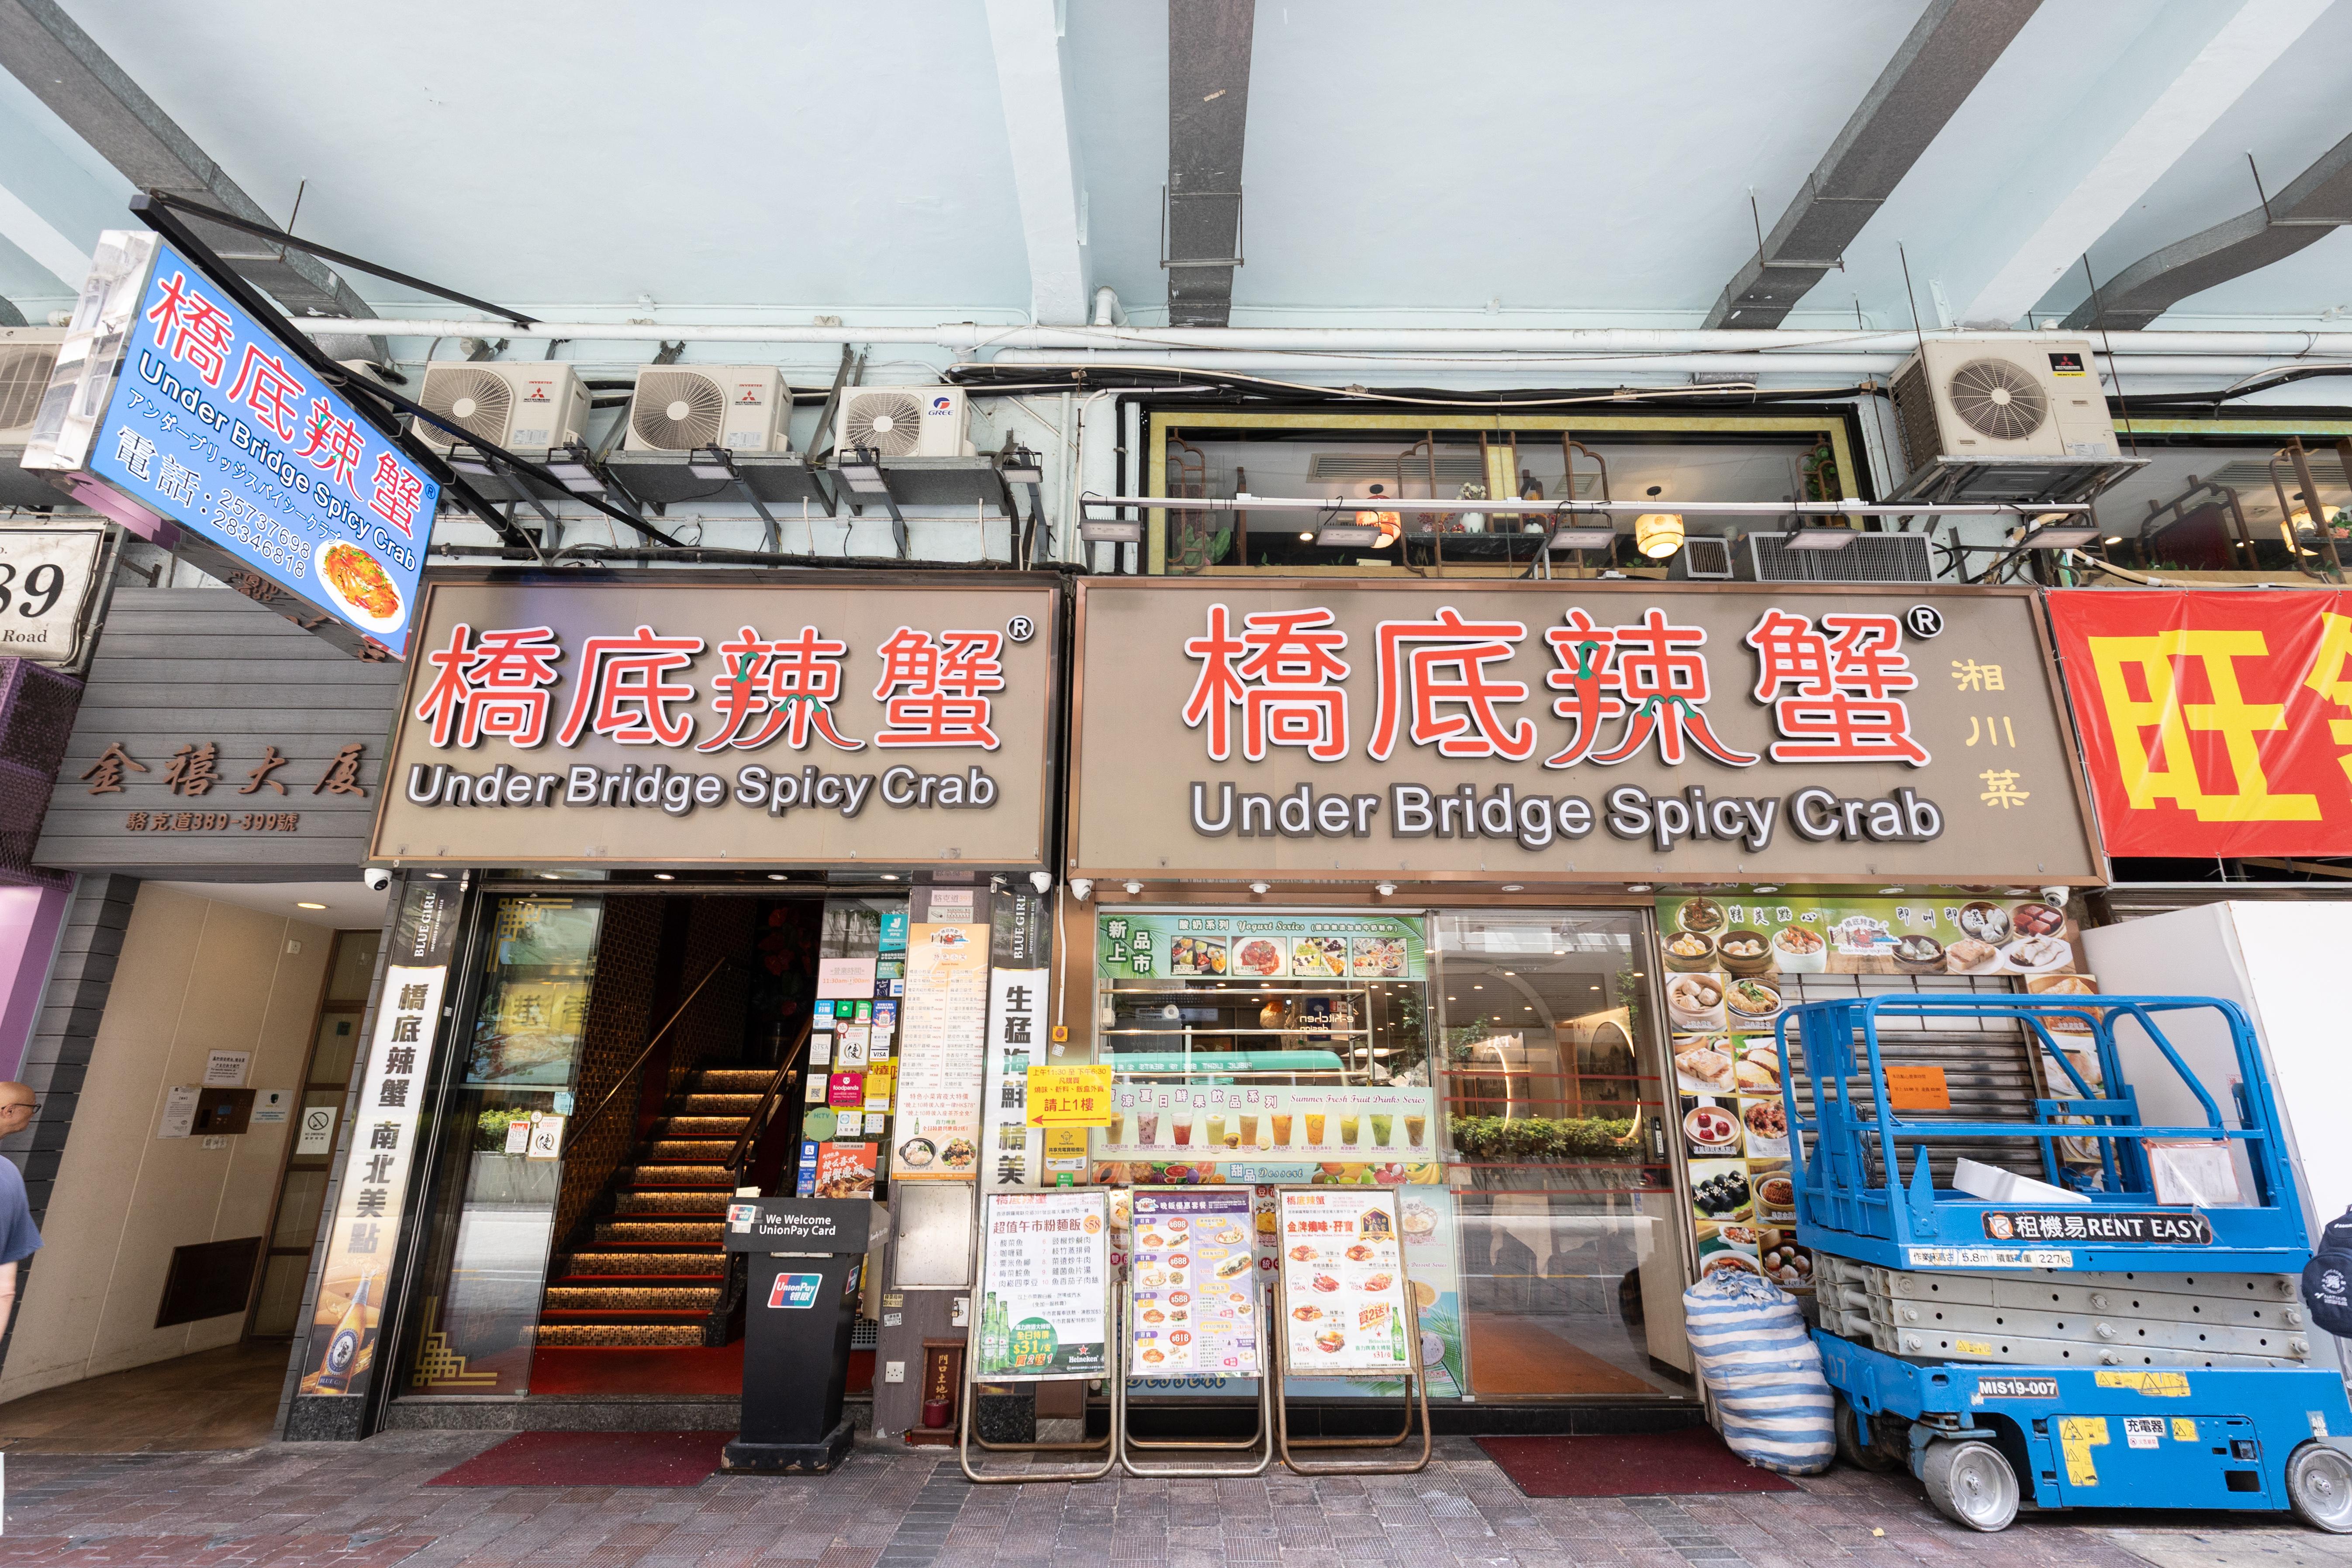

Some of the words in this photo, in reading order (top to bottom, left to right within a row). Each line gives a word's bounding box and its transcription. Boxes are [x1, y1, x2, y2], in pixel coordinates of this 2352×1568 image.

[146, 271, 424, 540] 橋底辣蟹
[138, 349, 229, 432] Under
[230, 418, 309, 494] Bridge
[314, 482, 371, 540] Spicy
[373, 528, 416, 571] Crab
[114, 425, 201, 509] 電話
[218, 488, 311, 560] 25737698
[212, 509, 305, 577] 28346818
[3, 630, 47, 643] Road
[416, 622, 1005, 753] 橋底辣蟹
[1182, 603, 1932, 767] 橋底辣蟹
[1951, 659, 2030, 809] 湘川菜
[407, 763, 559, 807] Under
[565, 763, 723, 817] Bridge
[734, 764, 873, 818] Spicy
[880, 764, 997, 809] Crab
[1190, 781, 1380, 838] Under
[1389, 782, 1594, 852] Bridge
[1606, 784, 1781, 853] Spicy
[1787, 786, 1945, 843] Crab
[1016, 895, 1026, 926] GIRL
[1729, 905, 1817, 926] 精美點心
[414, 925, 429, 957] BLUE
[422, 893, 436, 924] GIRL
[1178, 919, 1230, 930] 酸奶系列
[1237, 921, 1273, 933] Yogurt
[1276, 921, 1305, 931] Series
[1844, 918, 1876, 928] 橋底辣蟹
[1014, 927, 1024, 959] BLUE
[378, 983, 428, 1109] 橋底辣蟹
[1001, 985, 1033, 1108] 生猛海鮮
[1044, 1097, 1095, 1112] 請上1樓
[1290, 1094, 1323, 1104] Summer
[1325, 1094, 1347, 1103] Fresh
[1350, 1094, 1371, 1104] Fruit
[1372, 1094, 1400, 1104] Drinks
[1402, 1094, 1426, 1104] Series
[998, 1122, 1027, 1185] 精美
[1230, 1163, 1256, 1182] 甜品
[1258, 1167, 1303, 1178] Dessert
[348, 1121, 401, 1254] 南北美點
[1160, 1202, 1206, 1210] 晚飯優惠套餐
[1287, 1196, 1325, 1205] 橋底辣蟹
[766, 1214, 782, 1224] We
[784, 1214, 831, 1225] Welcome
[993, 1218, 1081, 1234] 超值午市粉麵飯
[1084, 1219, 1101, 1230] $58
[1170, 1220, 1186, 1229] $698
[759, 1225, 810, 1237] UnionPay
[811, 1225, 836, 1236] Card
[2015, 1216, 2087, 1238] 租機易
[2088, 1218, 2144, 1237] RENT
[2152, 1219, 2203, 1239] EASY
[1000, 1239, 1023, 1247] 酸菜魚
[1170, 1257, 1187, 1265] $688
[1961, 1253, 1989, 1263] 5.8m
[2038, 1254, 2071, 1264] 227kg
[777, 1282, 815, 1296] UnionPay
[790, 1292, 810, 1301] 银联
[1171, 1295, 1188, 1303] $588
[1358, 1302, 1389, 1325] 買2送1
[1016, 1331, 1050, 1340] 全日特價
[1172, 1334, 1189, 1342] $618
[1015, 1353, 1053, 1368] 買2送1
[1069, 1354, 1098, 1363] Heineken
[1979, 1381, 2056, 1396] MIS19-007
[2126, 1419, 2164, 1433] 充電器
